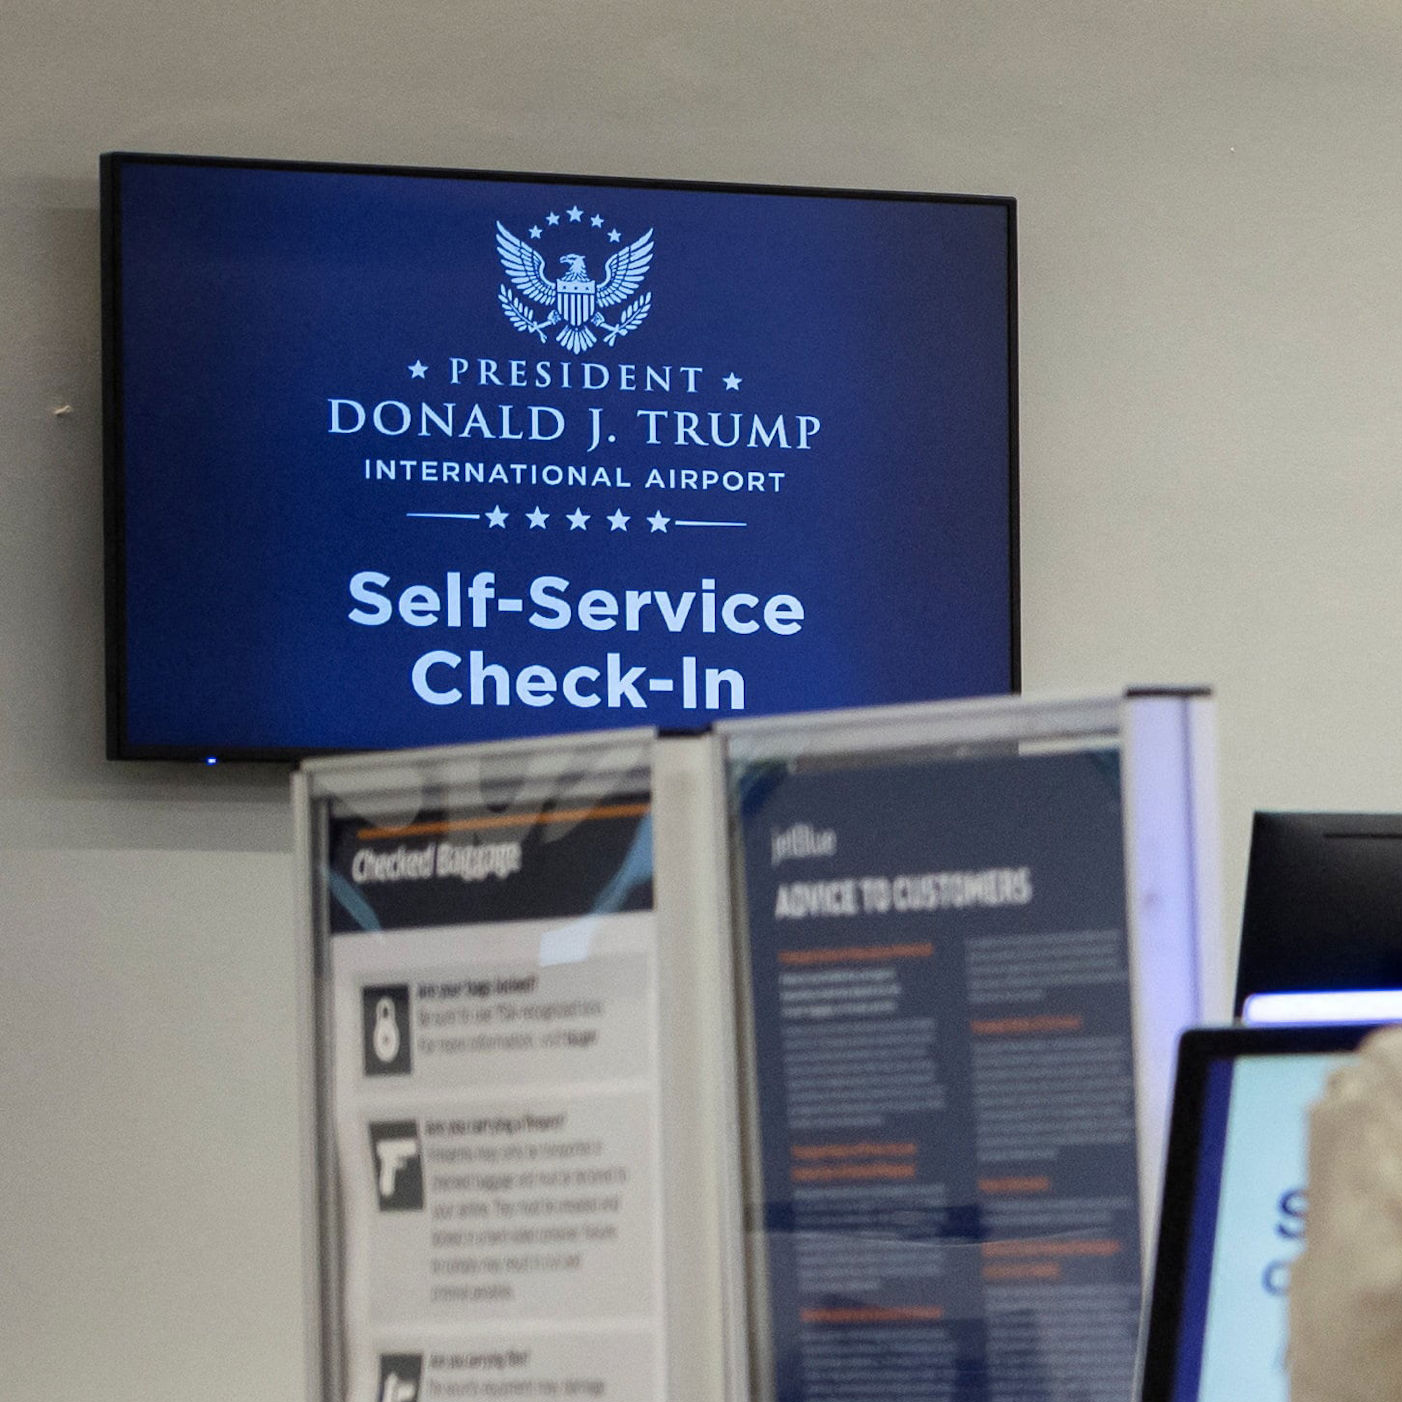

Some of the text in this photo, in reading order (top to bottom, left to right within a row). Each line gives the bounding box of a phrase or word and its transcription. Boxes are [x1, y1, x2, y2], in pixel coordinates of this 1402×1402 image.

[450, 358, 704, 393] PRESIDENT
[328, 397, 821, 452] DONALD J. TRUMP
[365, 459, 786, 493] INTERNATIONAL AIRPORT
[348, 571, 805, 635] Self-Service
[411, 650, 746, 710] Check-In
[352, 841, 522, 883] Checked Baggage
[775, 868, 1033, 920] ADVICE TO CUSTOMERS
